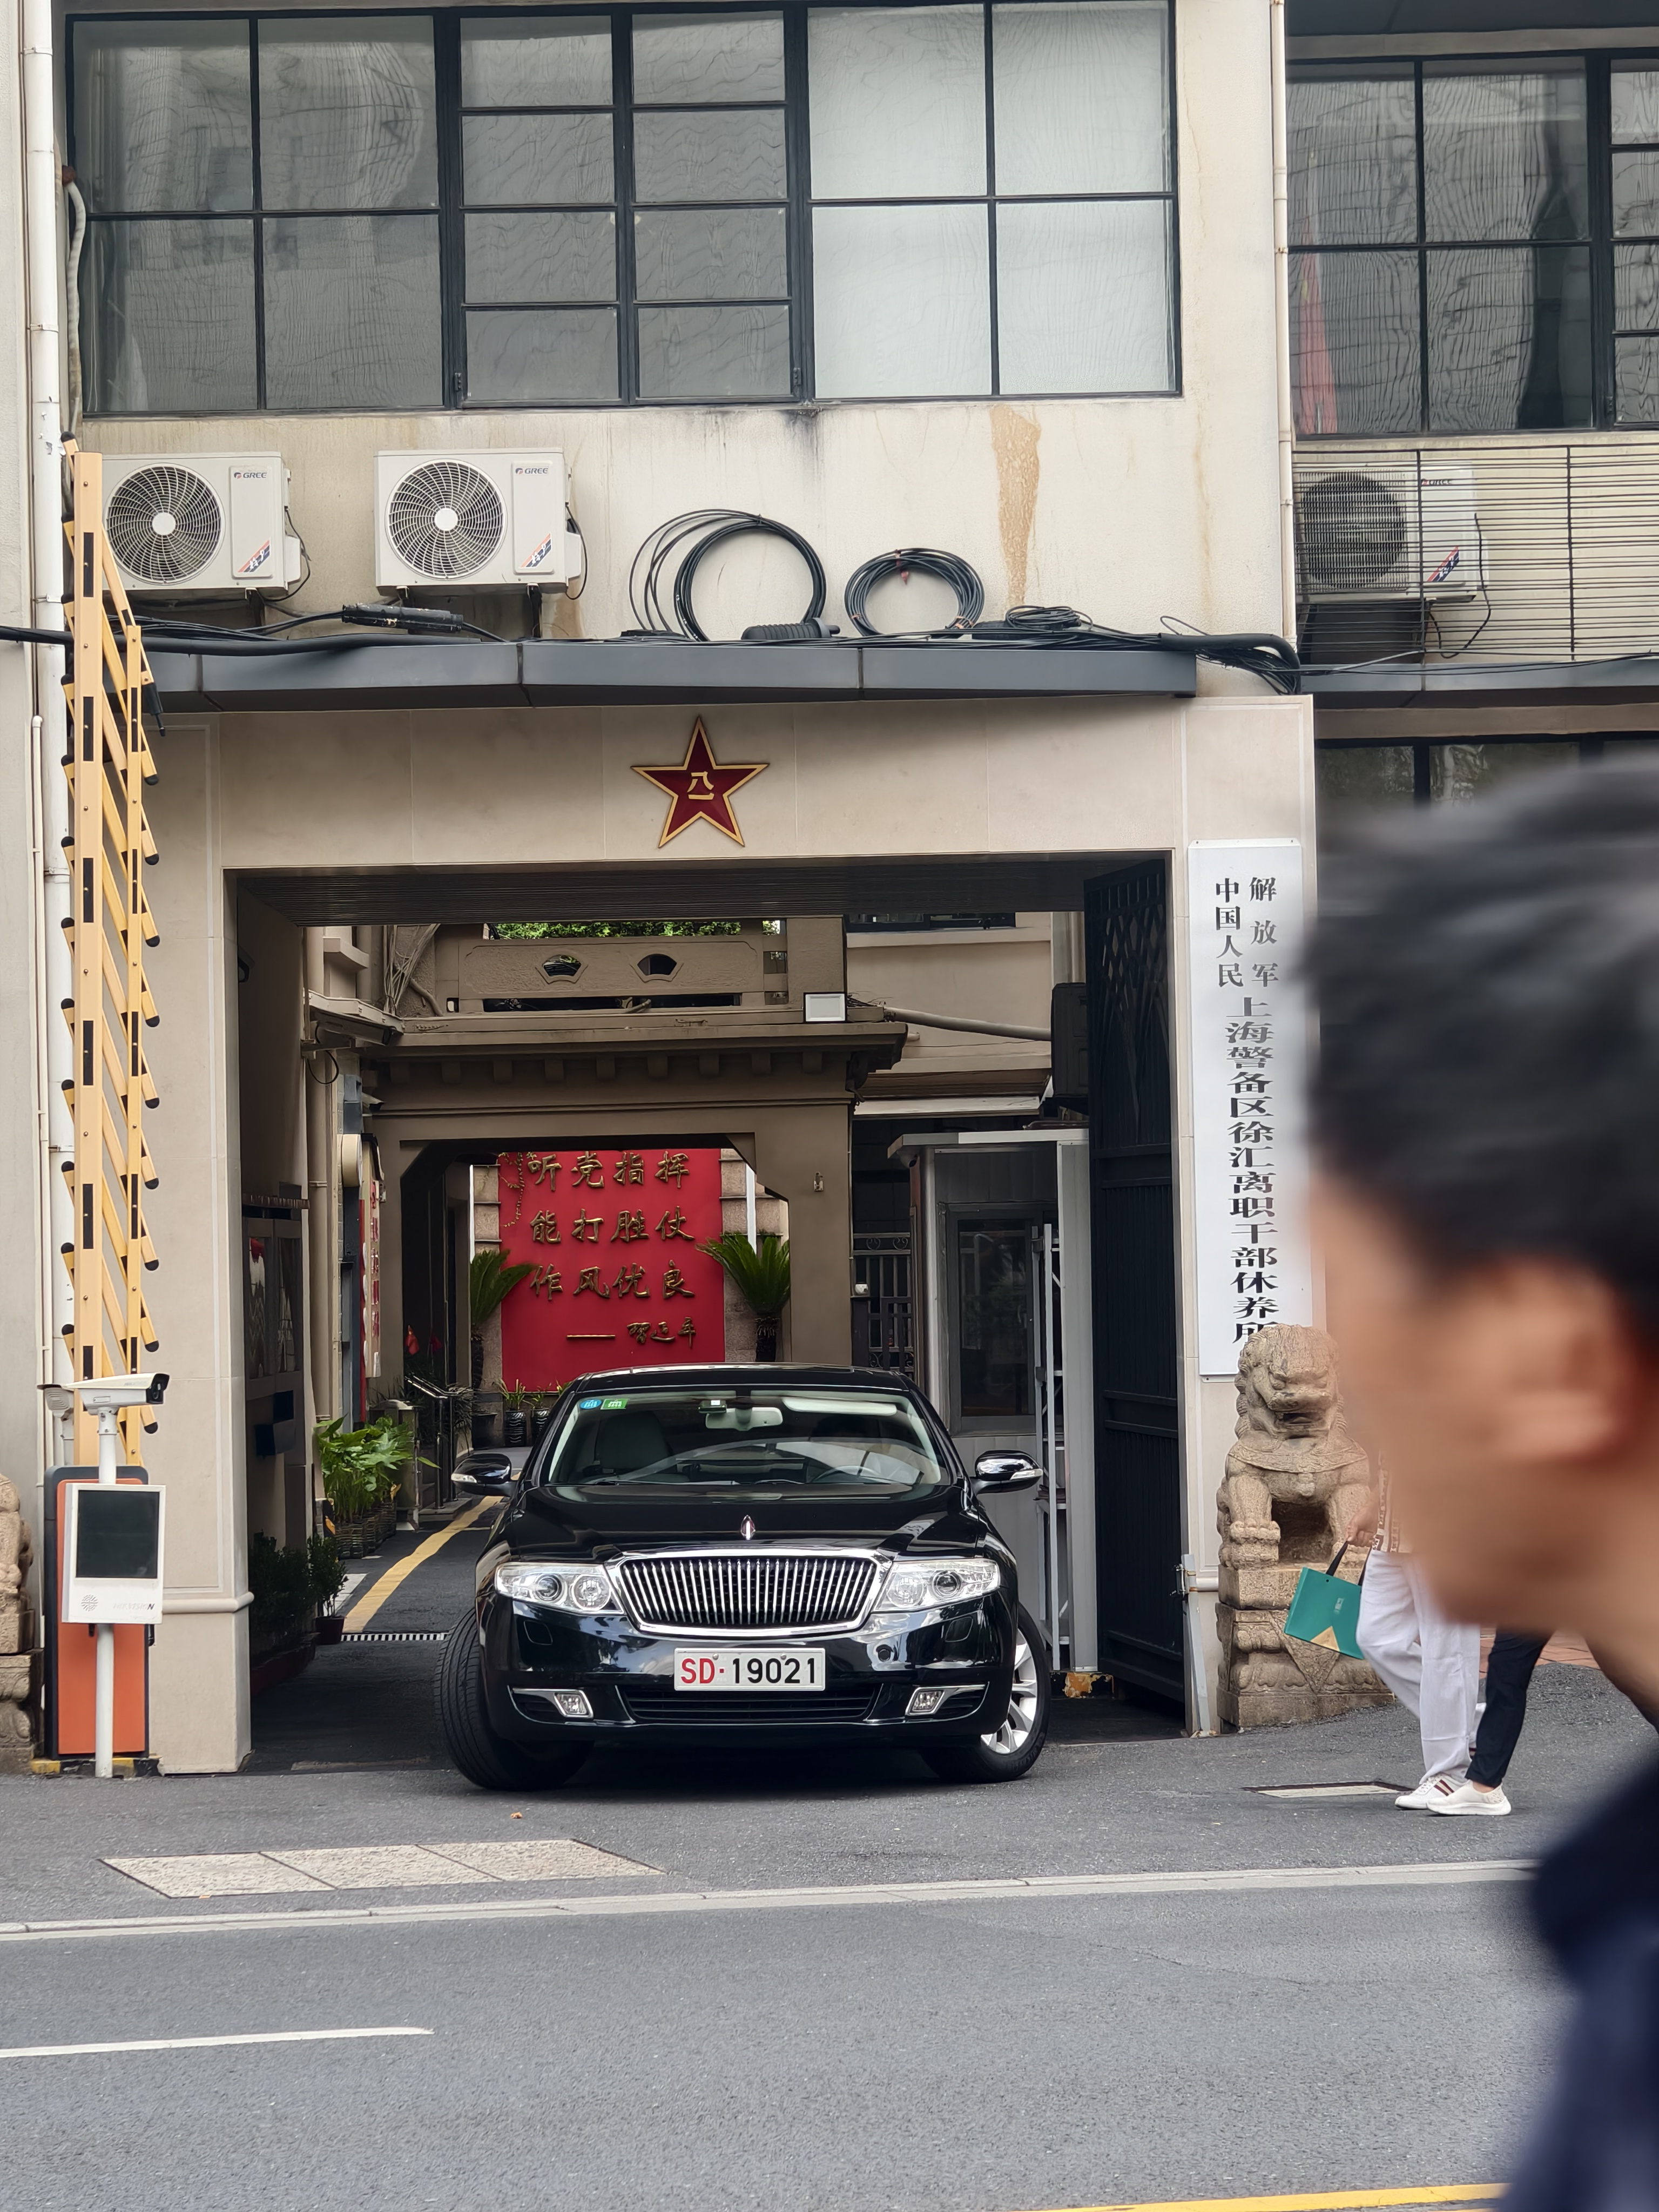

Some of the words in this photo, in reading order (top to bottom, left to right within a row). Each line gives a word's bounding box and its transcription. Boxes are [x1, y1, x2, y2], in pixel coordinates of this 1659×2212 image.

[1216, 878, 1243, 988] 中国人民
[1249, 876, 1279, 987] 解放军
[528, 1151, 690, 1191] 听党指挥
[530, 1205, 695, 1243] 能打胜仗
[530, 1260, 695, 1301] 作风优良
